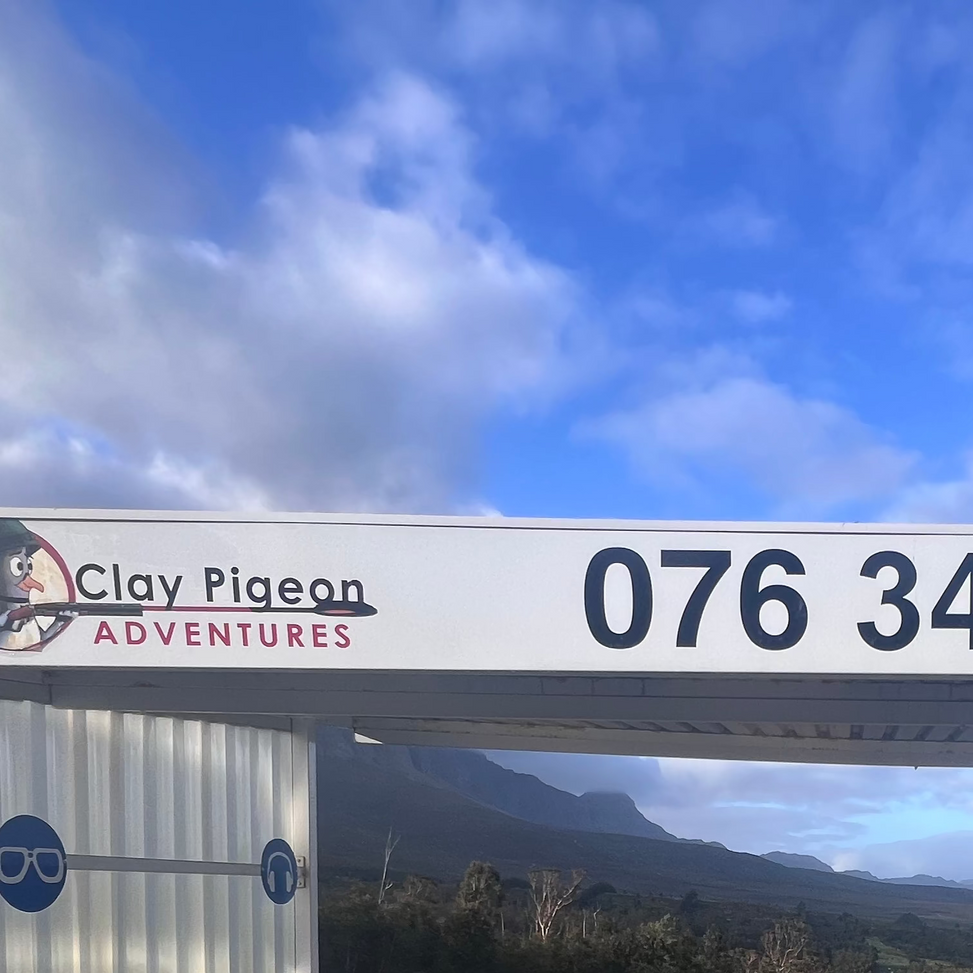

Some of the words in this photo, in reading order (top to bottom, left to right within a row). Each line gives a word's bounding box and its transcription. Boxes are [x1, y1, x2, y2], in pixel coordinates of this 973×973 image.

[75, 563, 183, 609] Clay
[204, 566, 364, 609] Pigeon
[583, 546, 808, 650] 076
[94, 620, 352, 650] ADVENTURES
